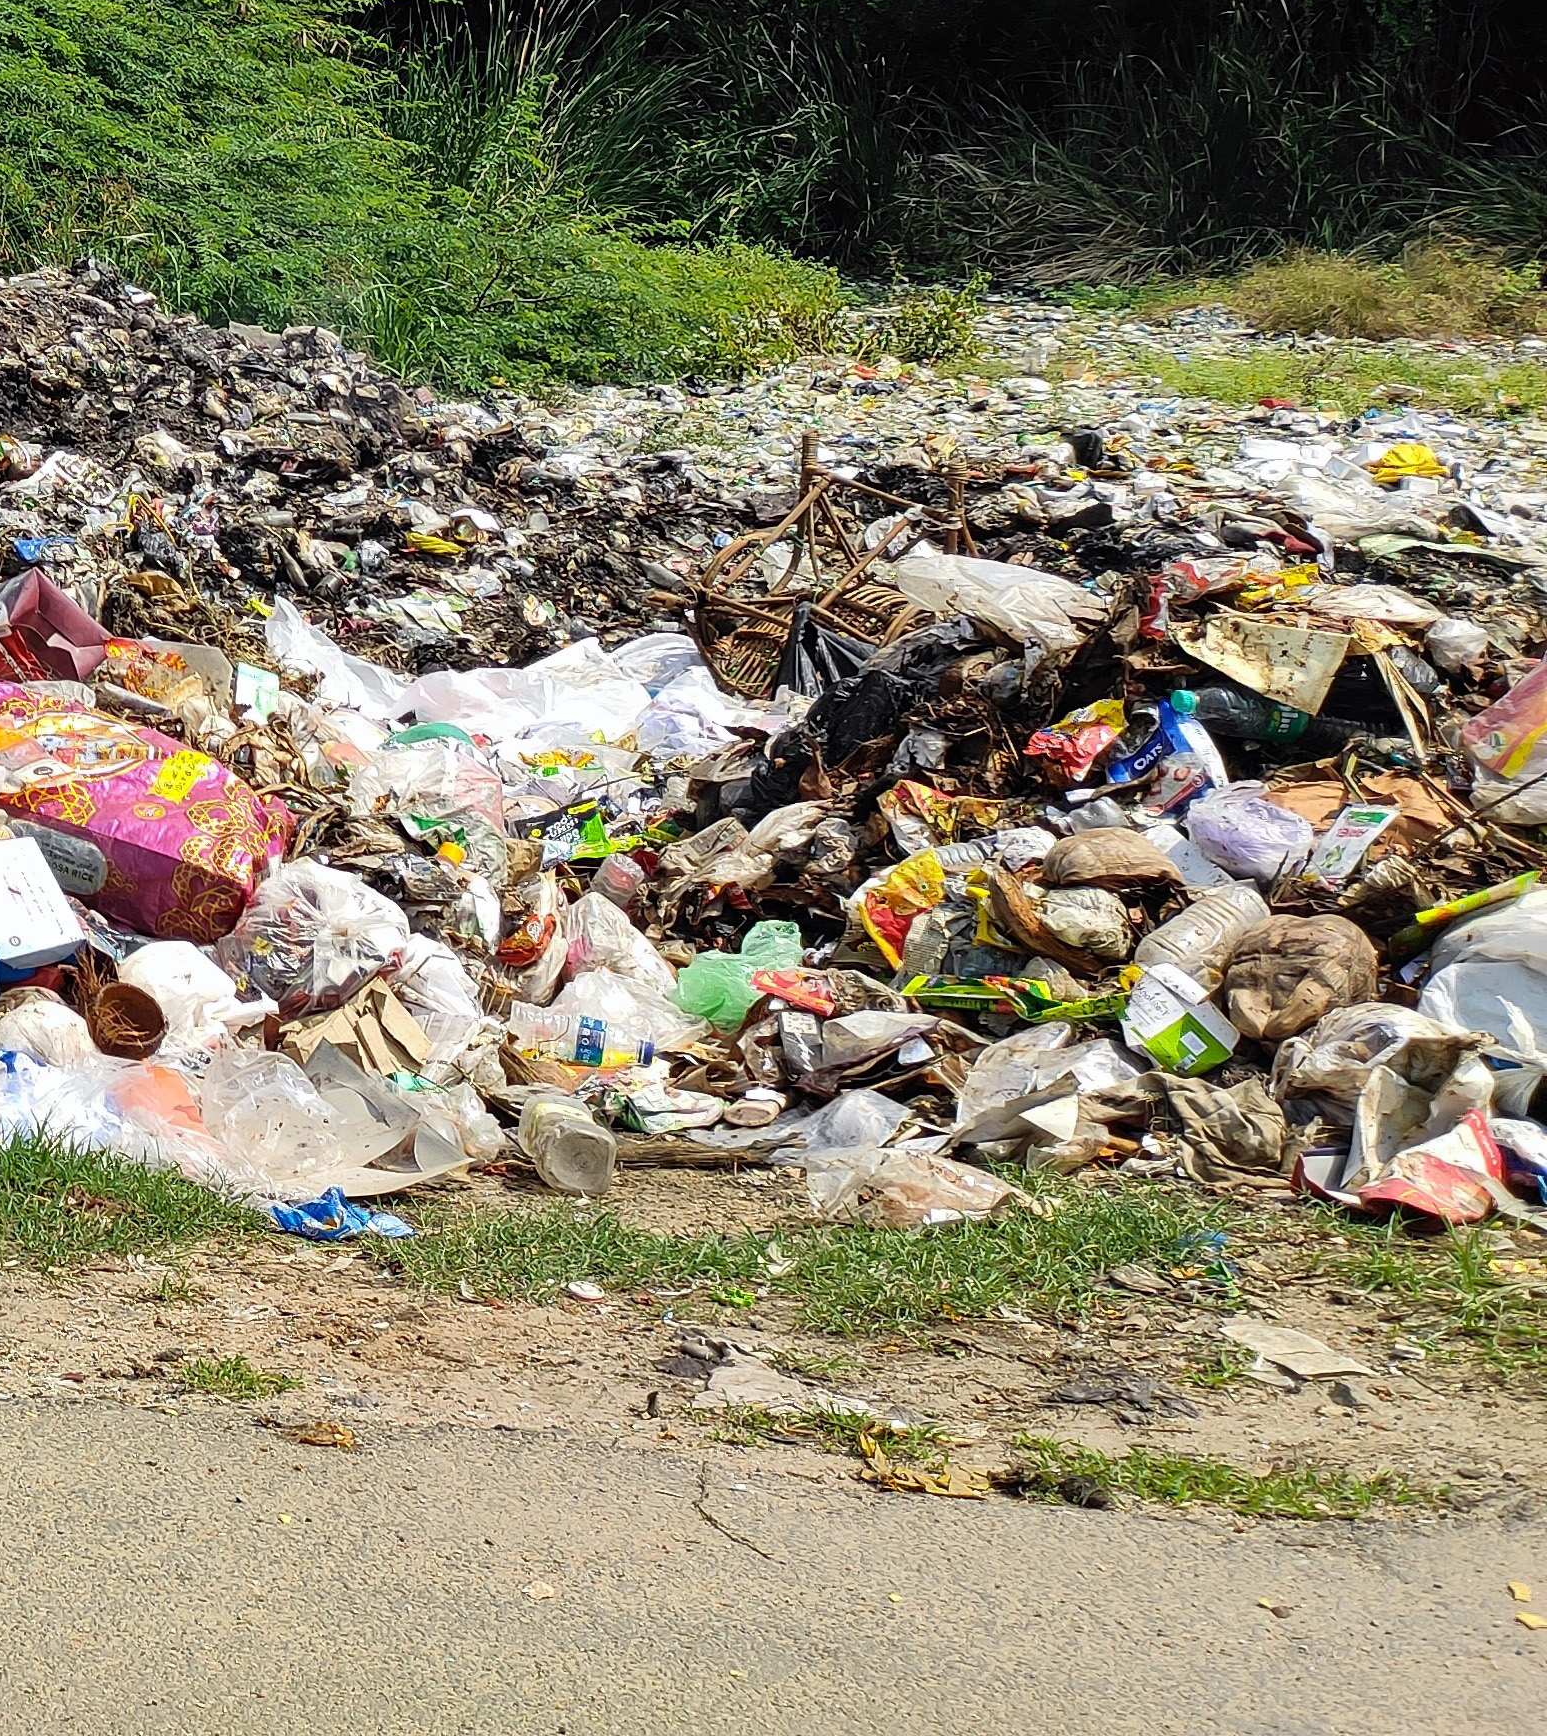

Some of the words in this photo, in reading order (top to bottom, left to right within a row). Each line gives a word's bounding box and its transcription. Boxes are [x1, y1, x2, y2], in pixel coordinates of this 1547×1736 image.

[1133, 742, 1163, 771] OATS
[51, 861, 69, 874] OSA
[71, 869, 95, 883] RICE
